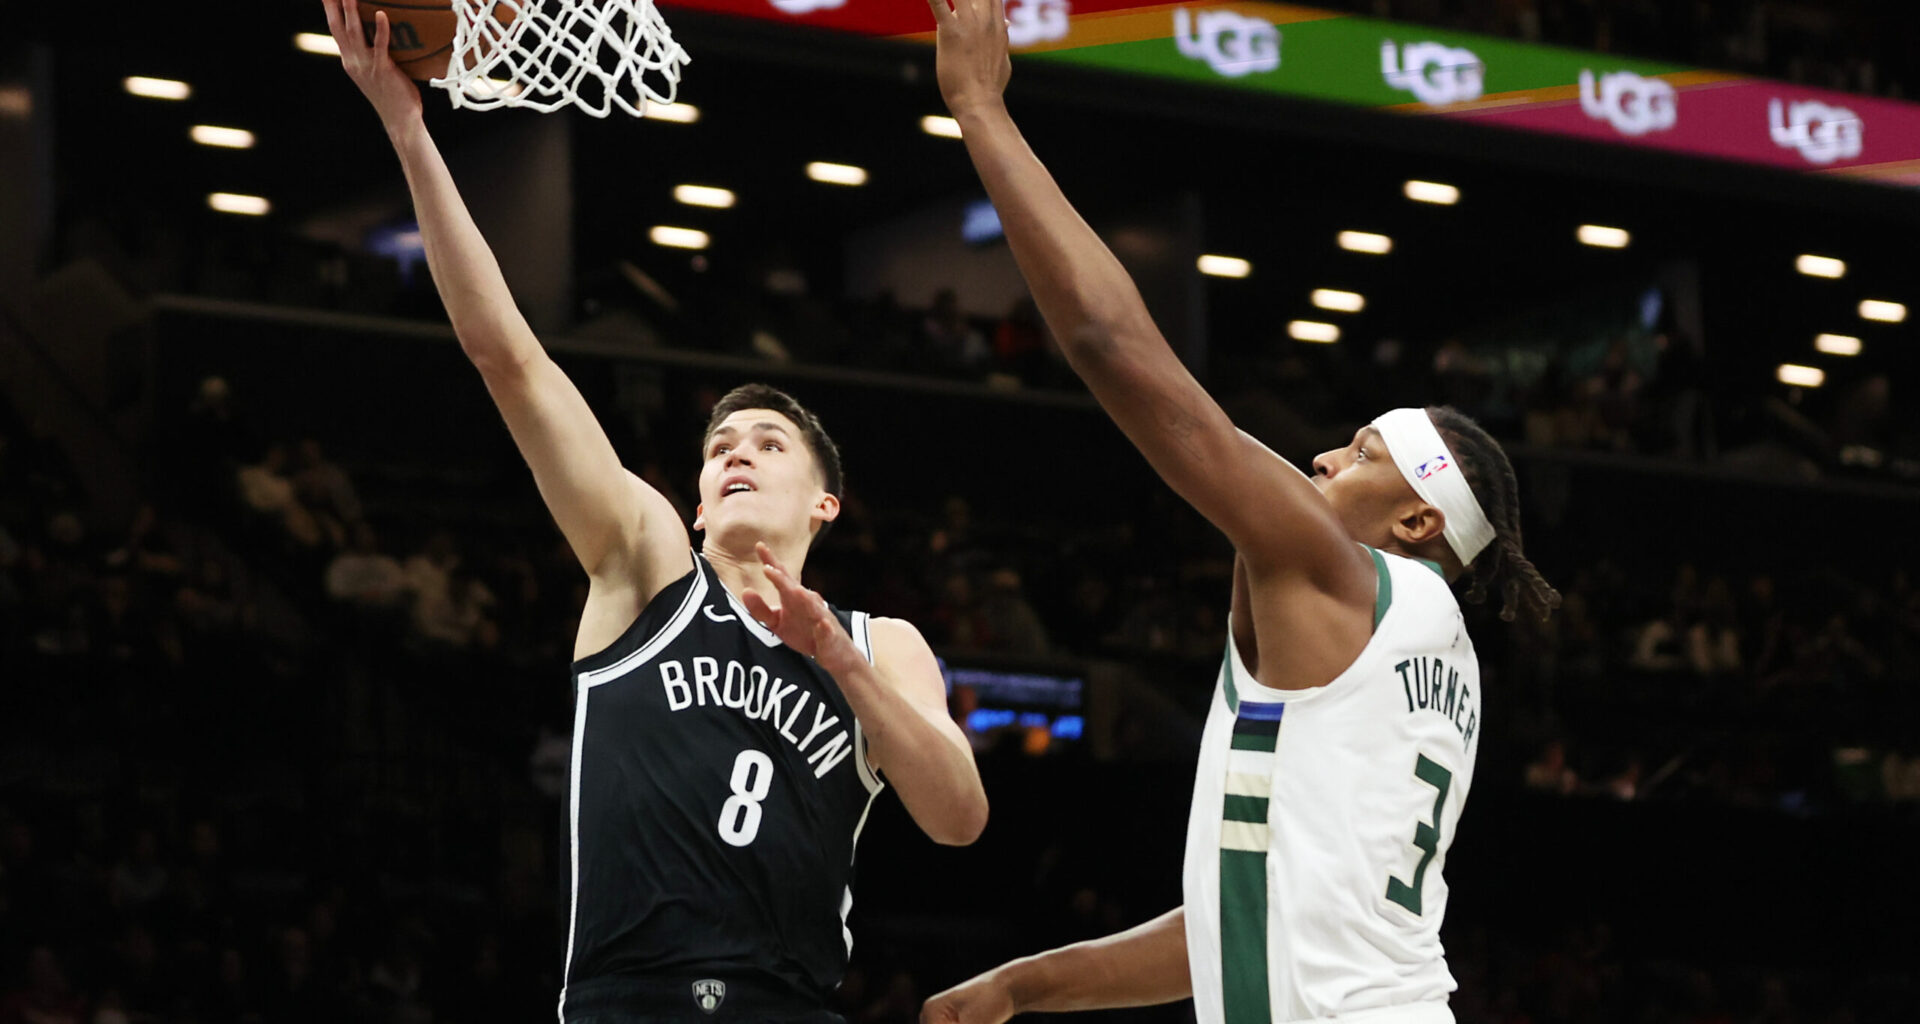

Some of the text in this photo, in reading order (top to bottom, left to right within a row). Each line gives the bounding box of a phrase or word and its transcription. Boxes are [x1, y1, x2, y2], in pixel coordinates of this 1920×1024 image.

[1173, 8, 1281, 77] UGG
[1380, 40, 1484, 107] UGG
[1578, 70, 1677, 135] UGG
[1769, 100, 1862, 163] UGG
[659, 656, 852, 779] BROOKLYN
[1394, 656, 1477, 752] TURNER
[717, 749, 774, 847] 8
[1385, 752, 1453, 918] 3
[696, 982, 723, 997] NETS
